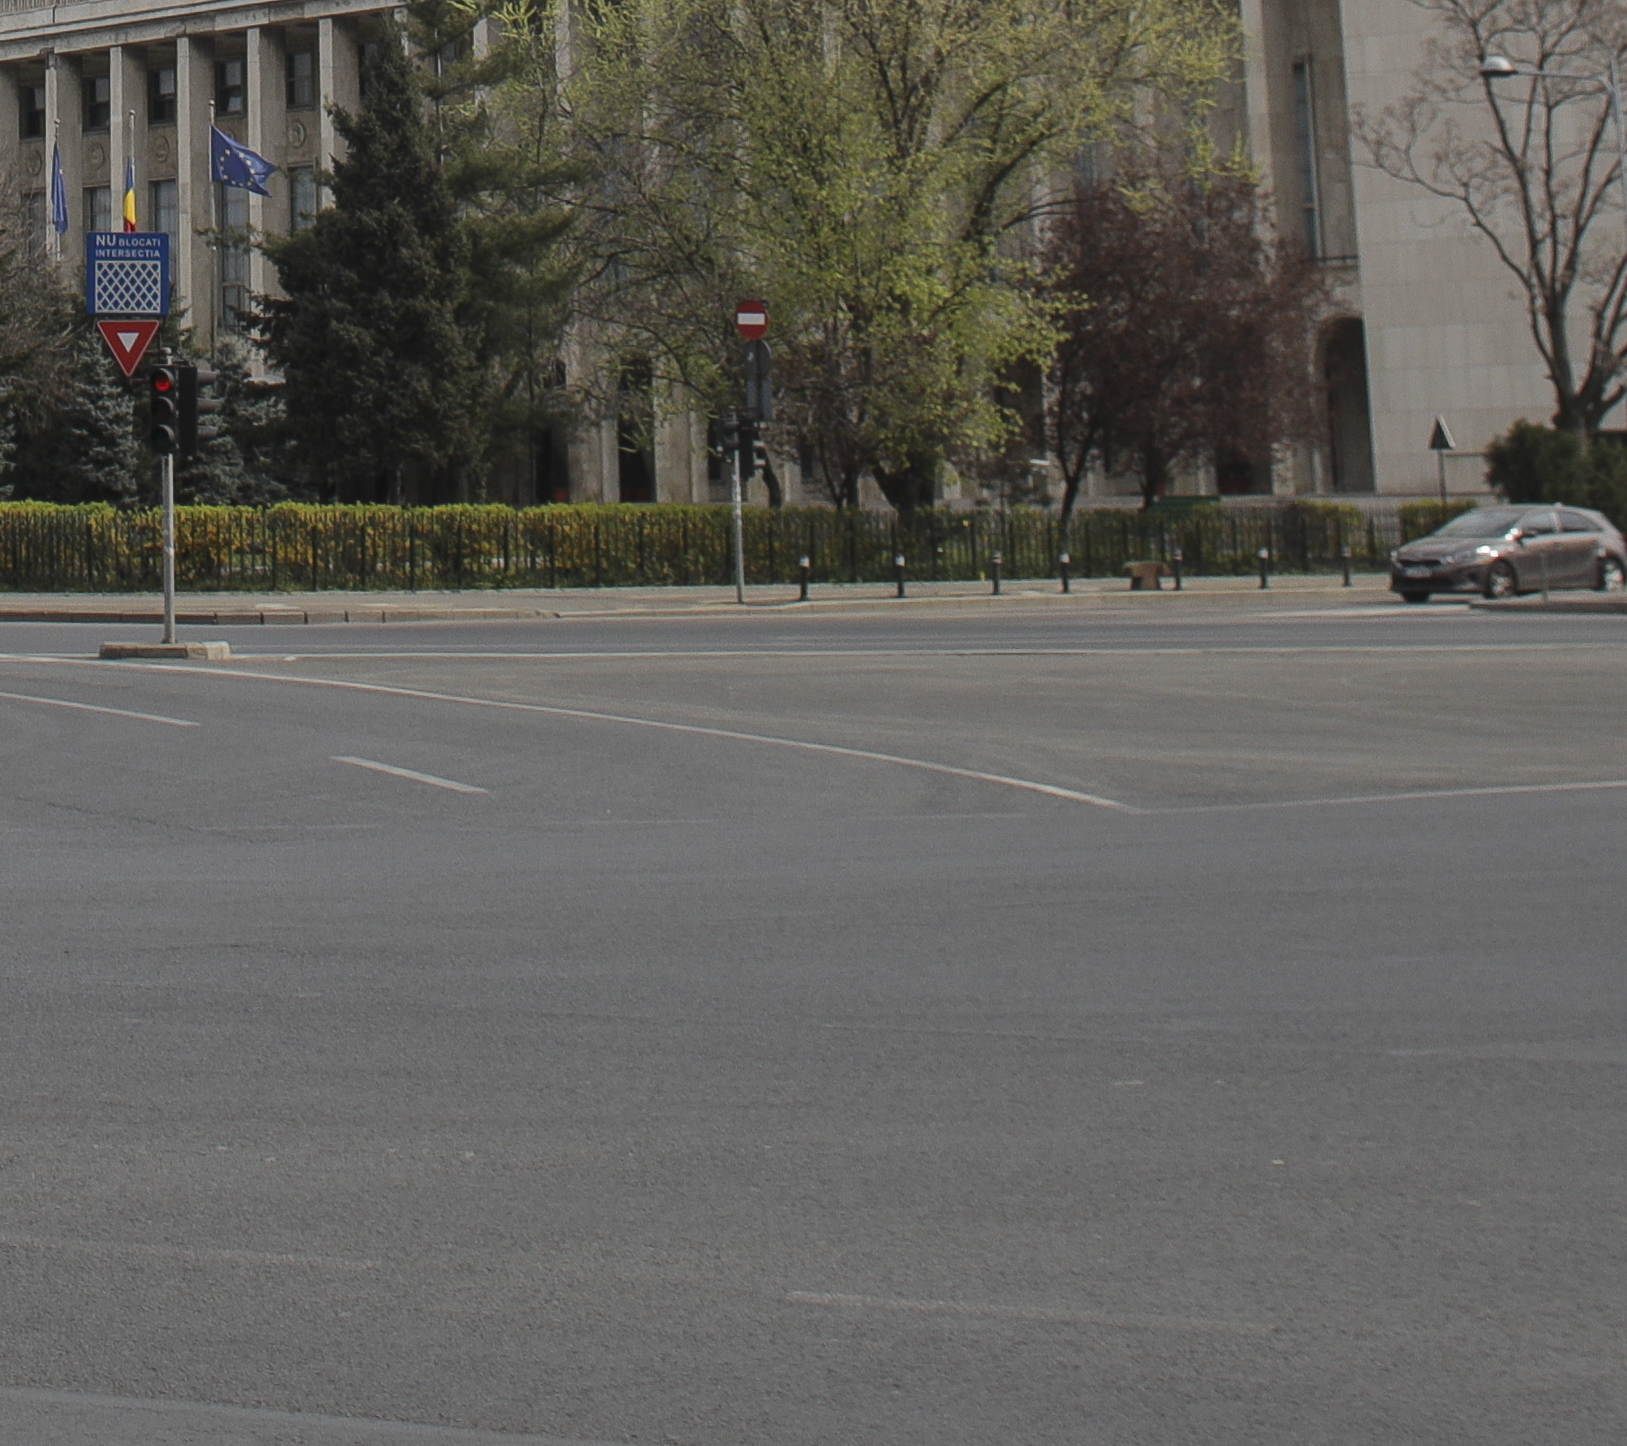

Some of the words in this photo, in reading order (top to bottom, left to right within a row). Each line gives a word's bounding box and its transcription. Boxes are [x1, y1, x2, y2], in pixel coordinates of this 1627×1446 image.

[96, 234, 117, 247] NU
[118, 238, 161, 247] BLOCATI
[95, 249, 161, 258] INTERSECTIA
